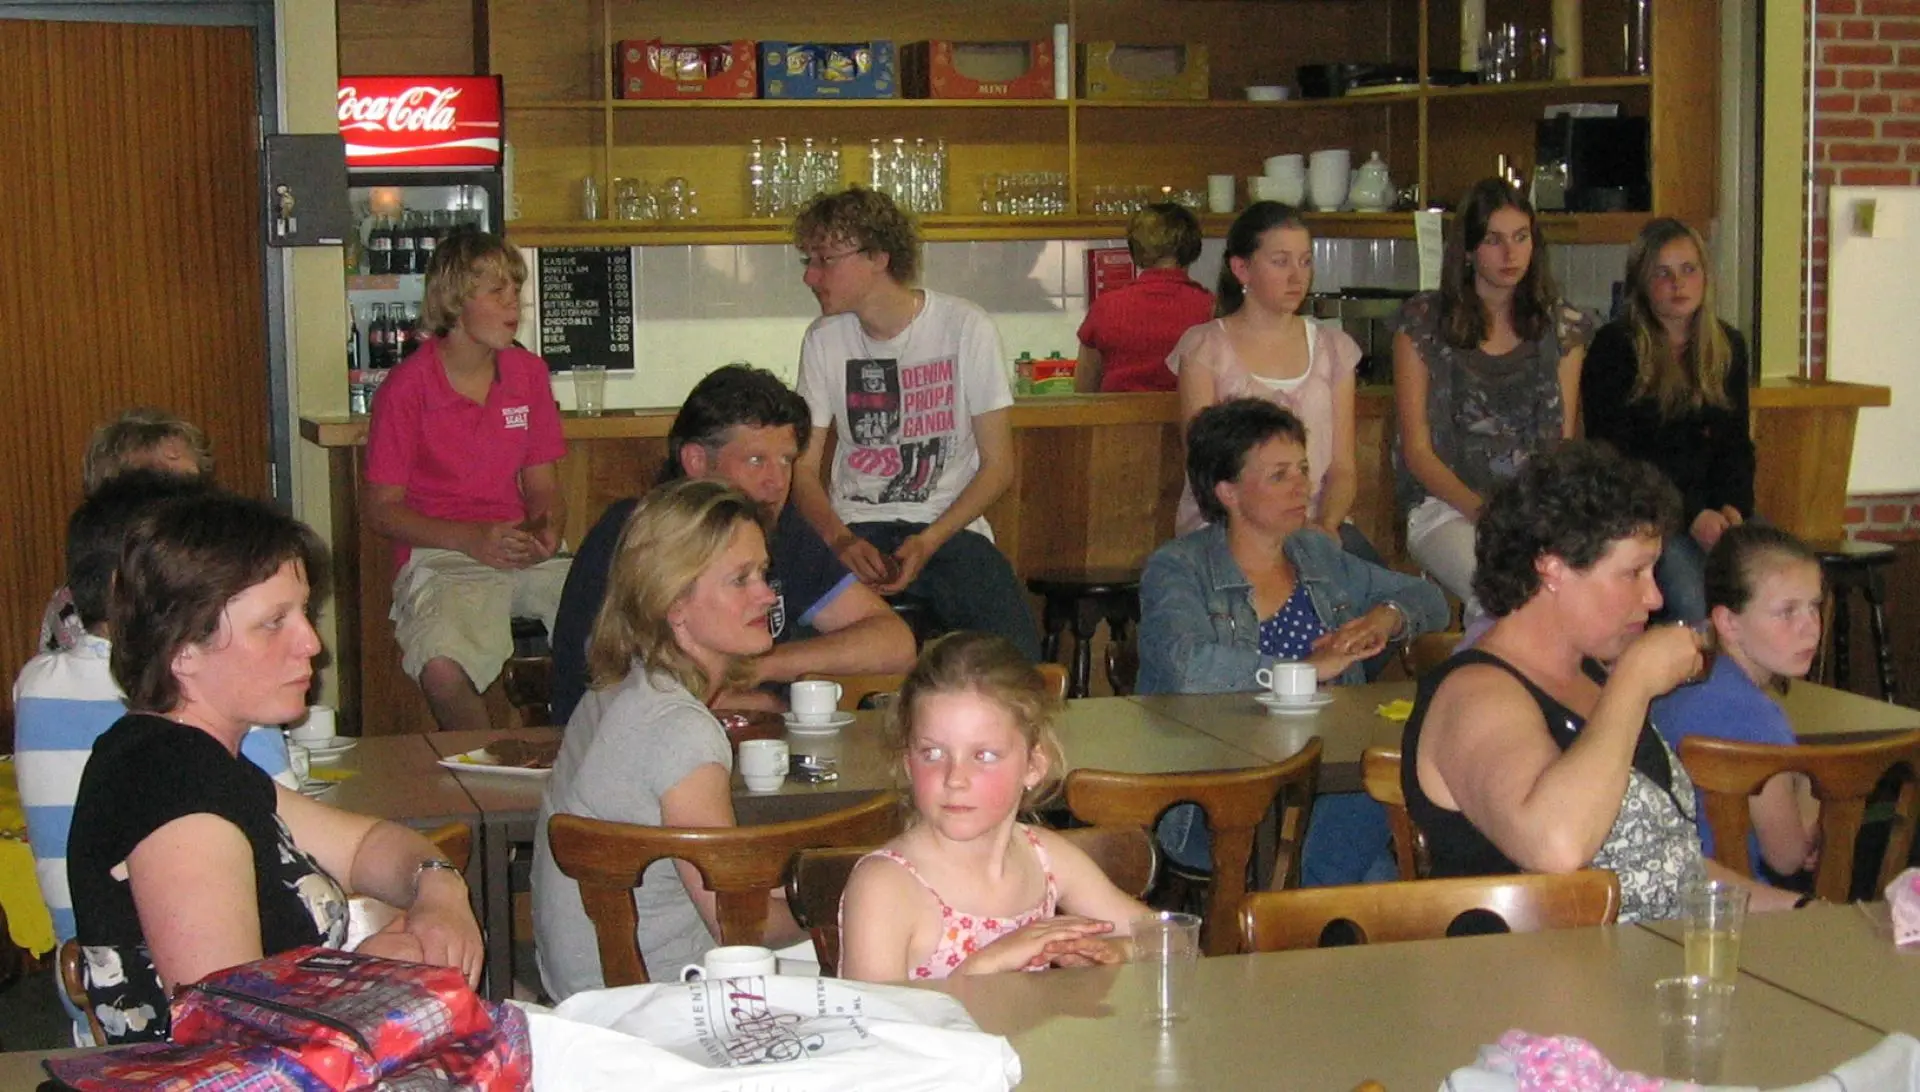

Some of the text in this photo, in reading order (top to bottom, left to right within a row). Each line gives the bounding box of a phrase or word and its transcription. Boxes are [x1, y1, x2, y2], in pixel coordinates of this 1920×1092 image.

[544, 275, 567, 283] COLA
[902, 360, 953, 390] DENIM
[904, 384, 954, 413] PROPA
[904, 410, 955, 438] GANDA
